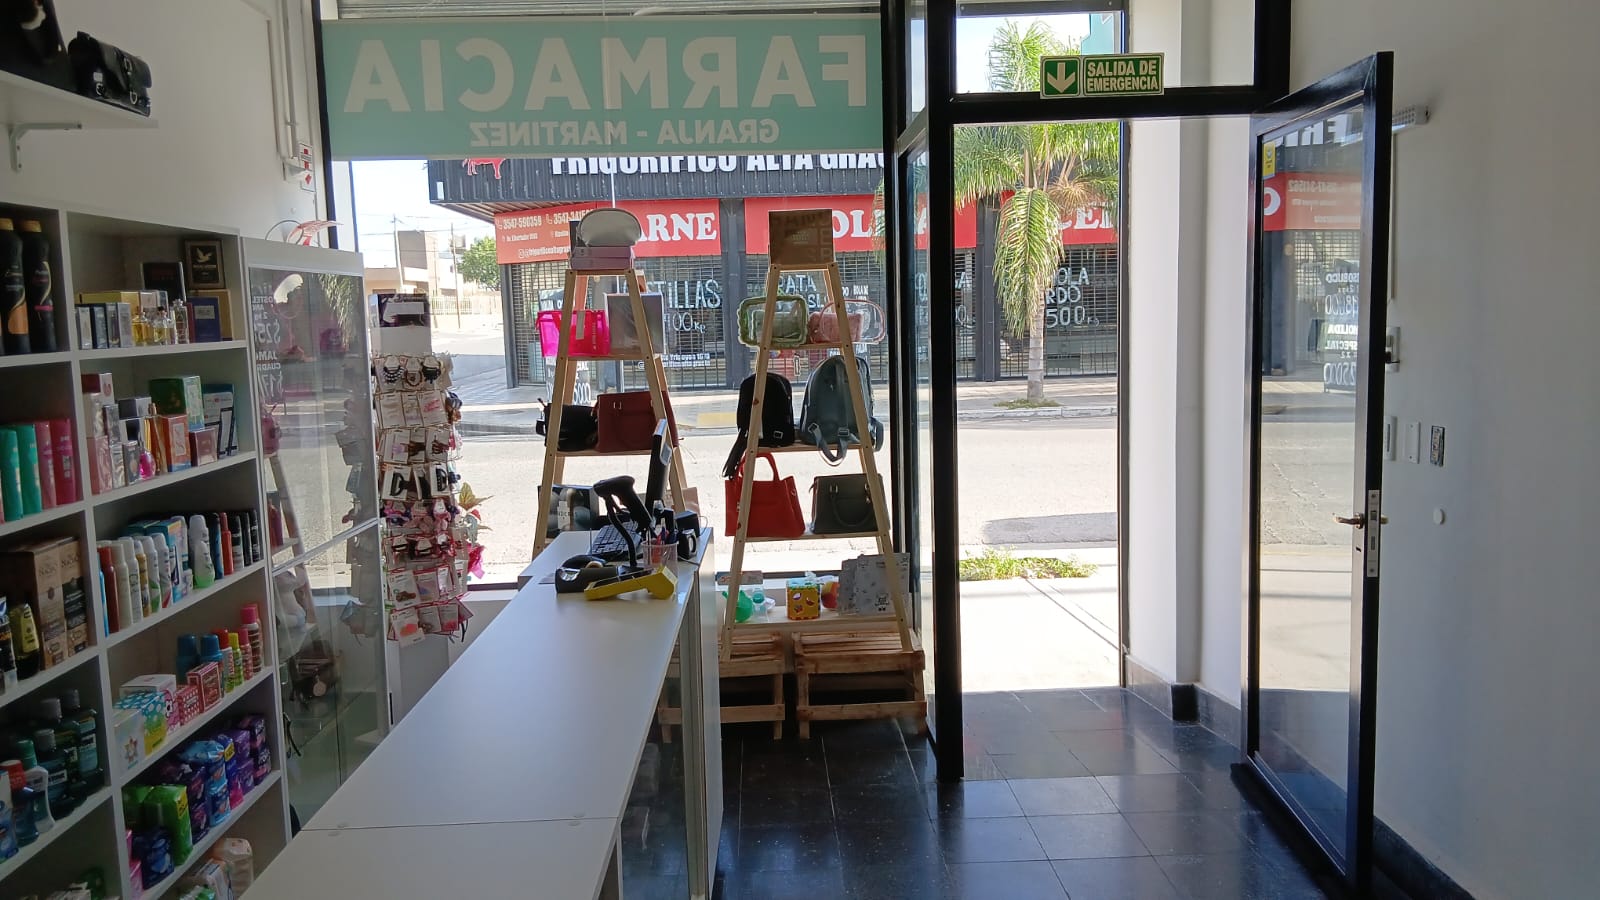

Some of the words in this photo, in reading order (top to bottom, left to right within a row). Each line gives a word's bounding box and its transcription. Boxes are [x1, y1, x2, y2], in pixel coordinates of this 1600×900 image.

[1087, 61, 1135, 77] SALIDA
[1140, 60, 1157, 75] DE
[1087, 76, 1158, 92] EMERGENCIA
